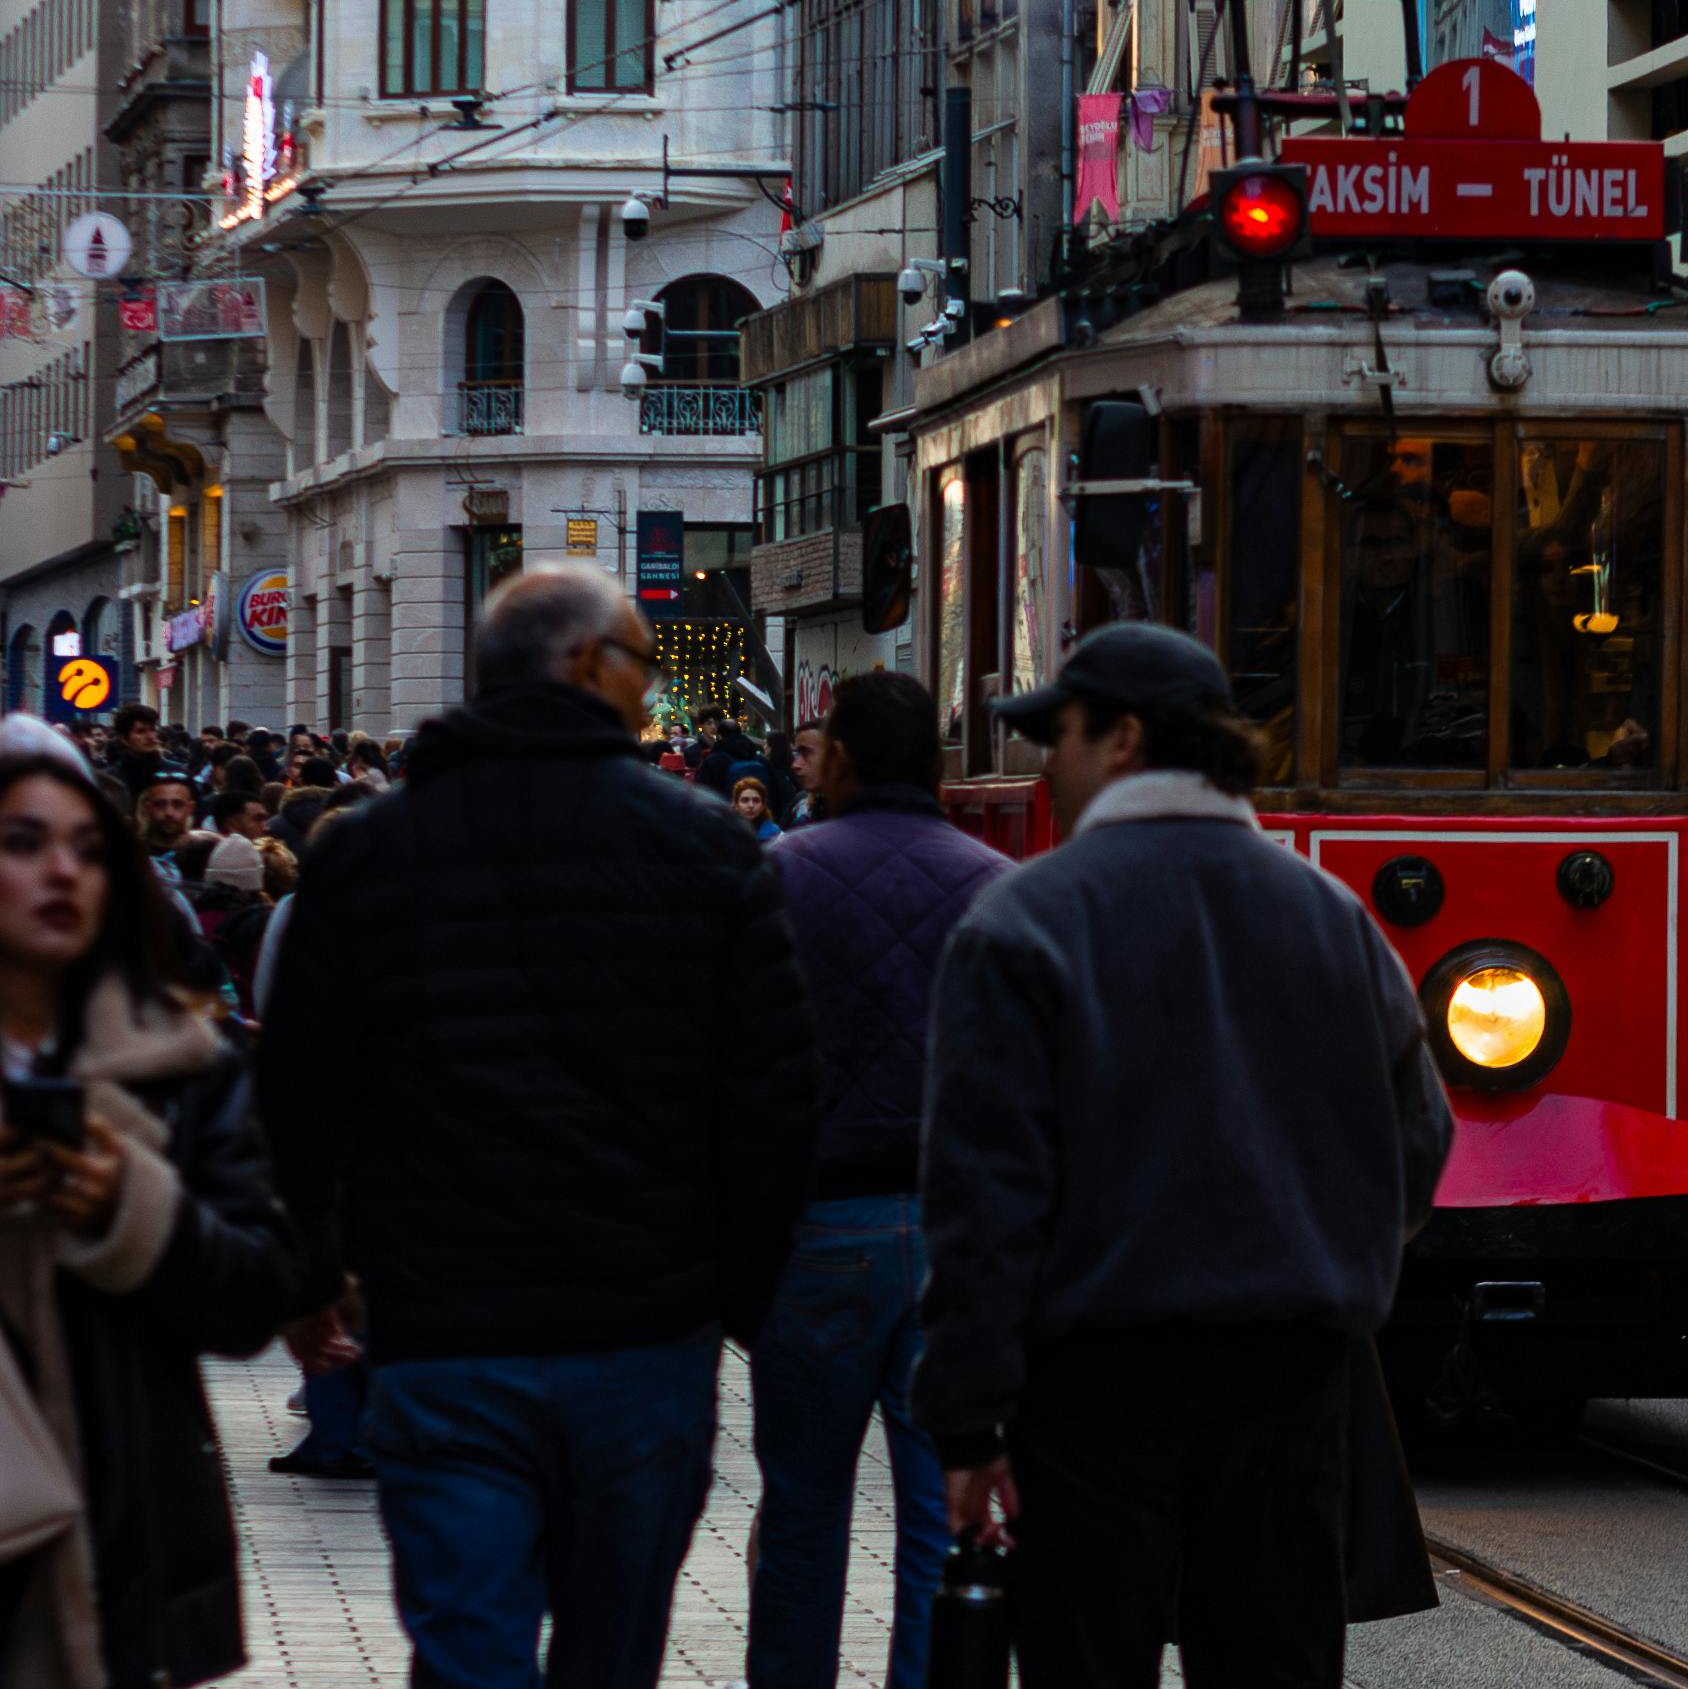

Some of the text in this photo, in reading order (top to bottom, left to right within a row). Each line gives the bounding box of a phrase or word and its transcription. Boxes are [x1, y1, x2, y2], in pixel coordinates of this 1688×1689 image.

[1461, 66, 1480, 127] 1
[1305, 152, 1430, 214] AKSİM
[1524, 155, 1649, 218] TÜNEL
